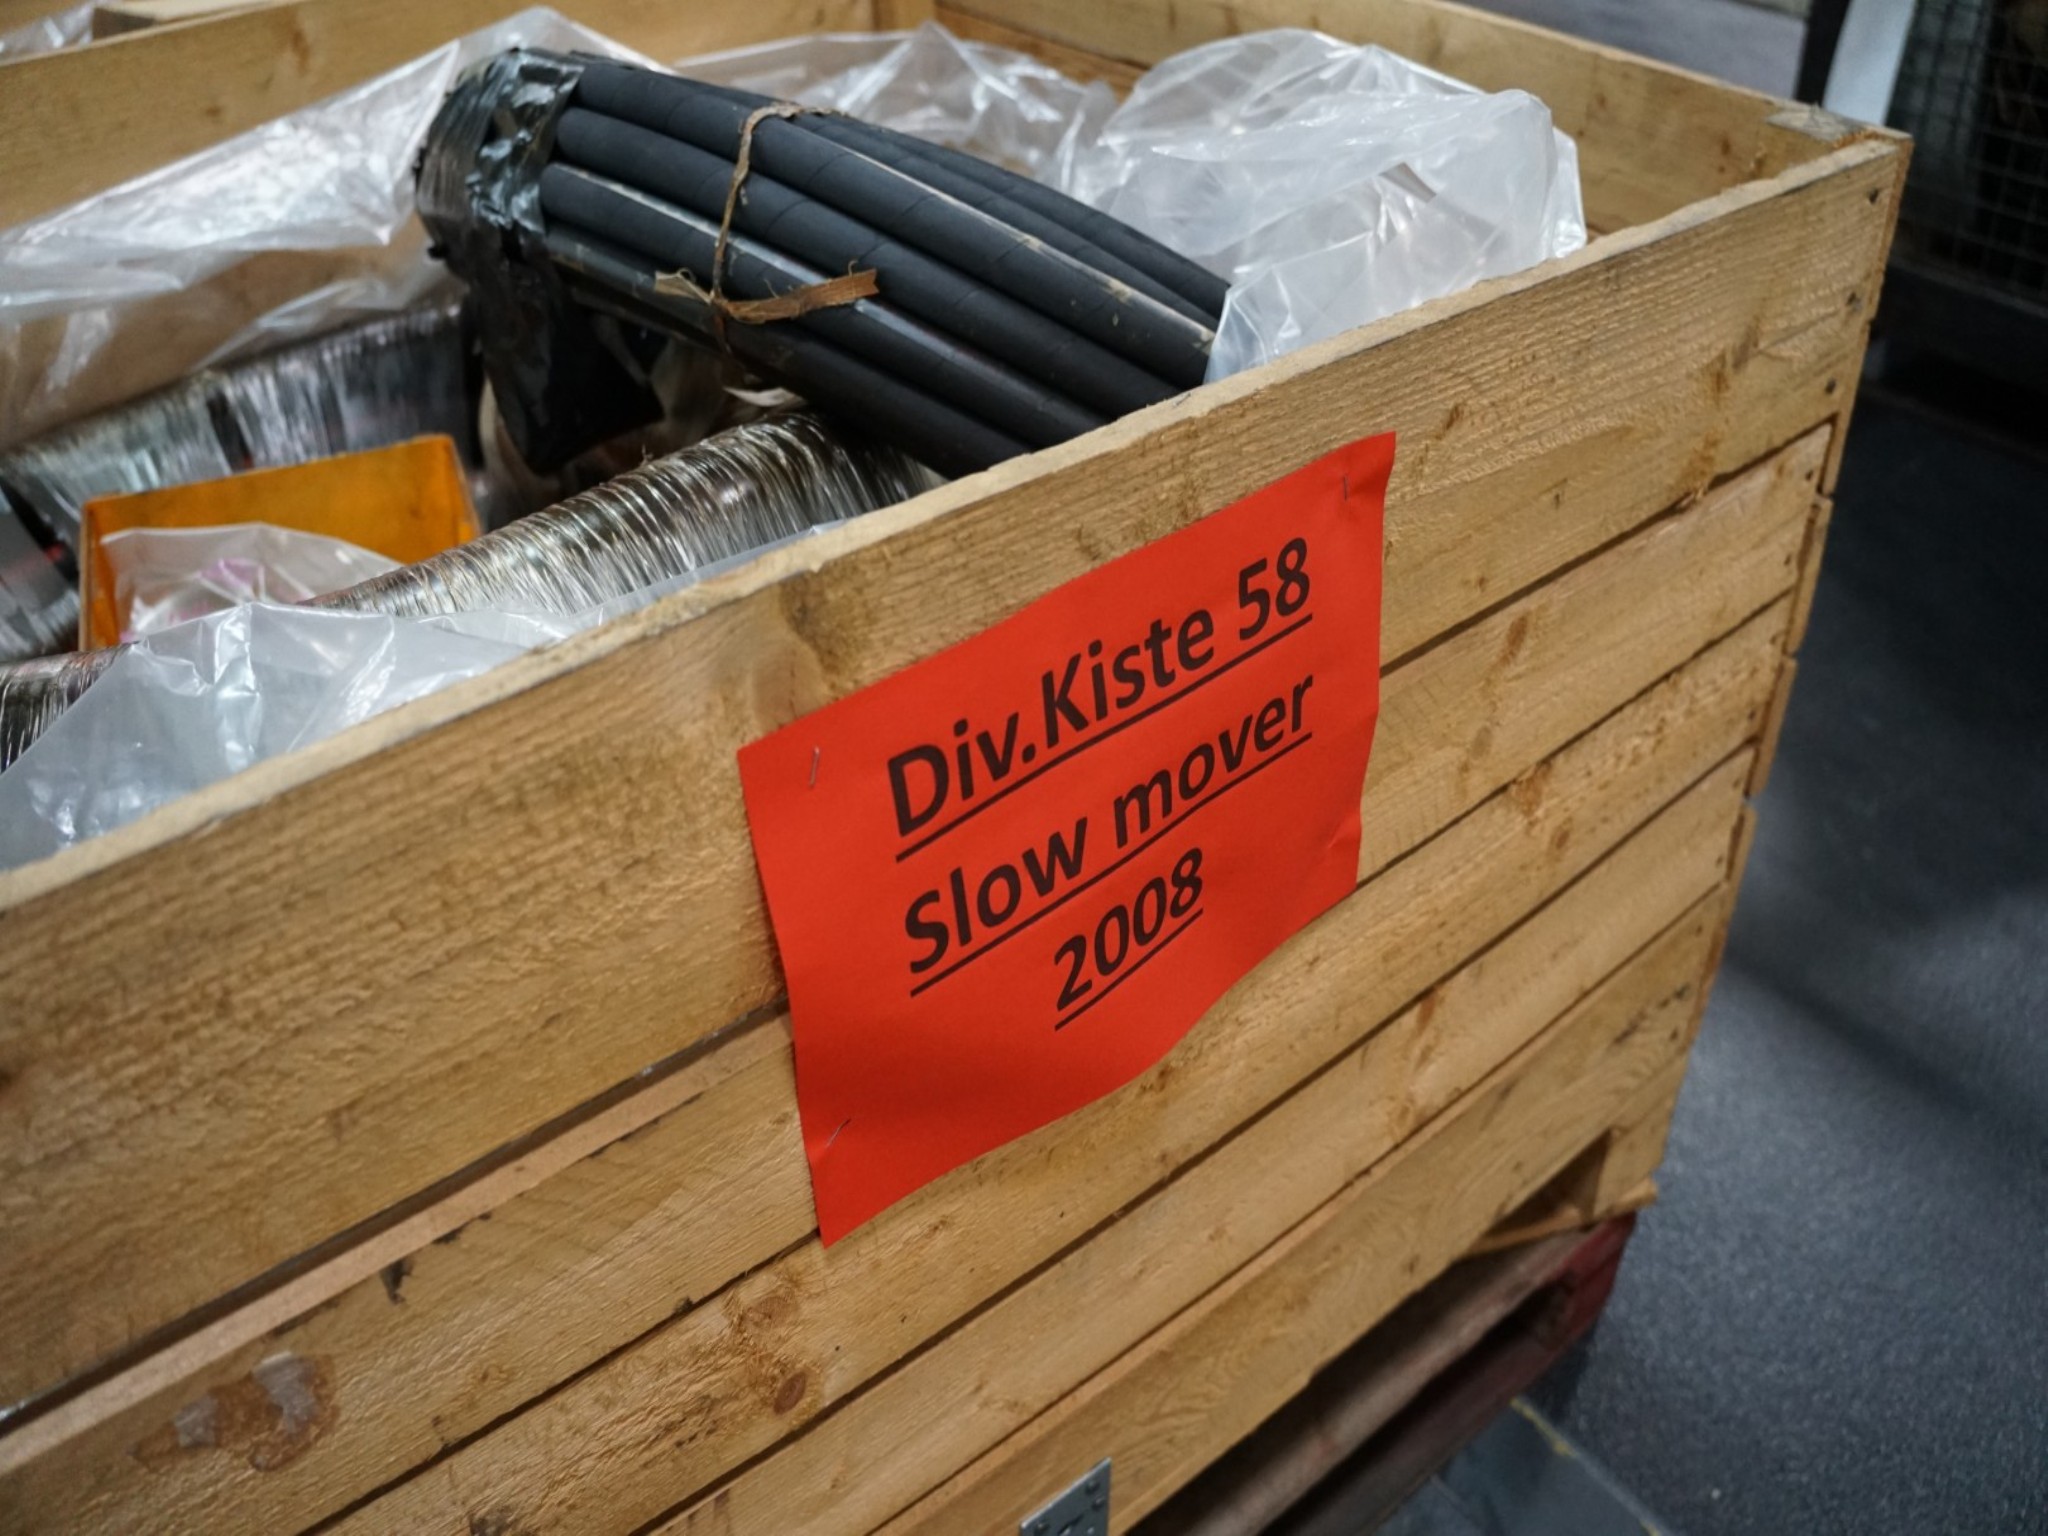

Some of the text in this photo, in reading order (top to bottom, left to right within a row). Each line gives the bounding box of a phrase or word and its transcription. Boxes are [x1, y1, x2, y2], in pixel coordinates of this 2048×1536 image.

[1238, 537, 1310, 641] 58
[905, 675, 1313, 974] Slow mover
[1054, 847, 1203, 1011] 2008
